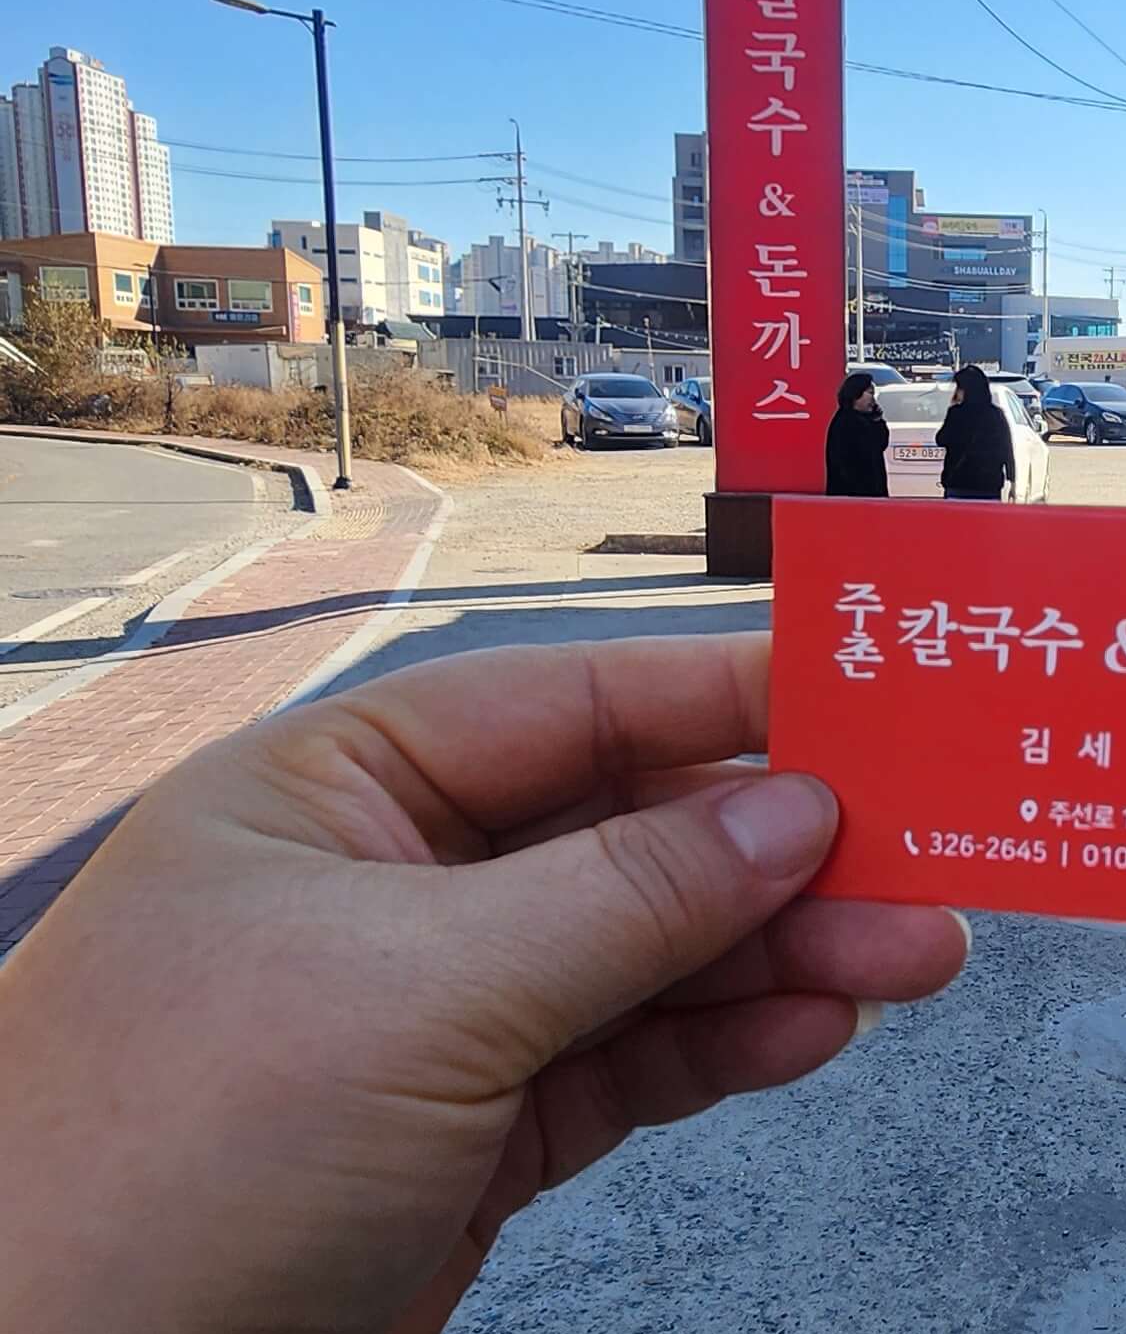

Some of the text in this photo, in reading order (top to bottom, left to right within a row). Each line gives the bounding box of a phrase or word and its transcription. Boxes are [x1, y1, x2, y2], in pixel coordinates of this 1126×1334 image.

[759, 182, 796, 217] &
[748, 244, 811, 420] 돈까스
[834, 583, 886, 679] 주촌
[898, 601, 1084, 677] 칼국수
[1049, 800, 1116, 831] 주선로
[928, 831, 1048, 864] 326-2645
